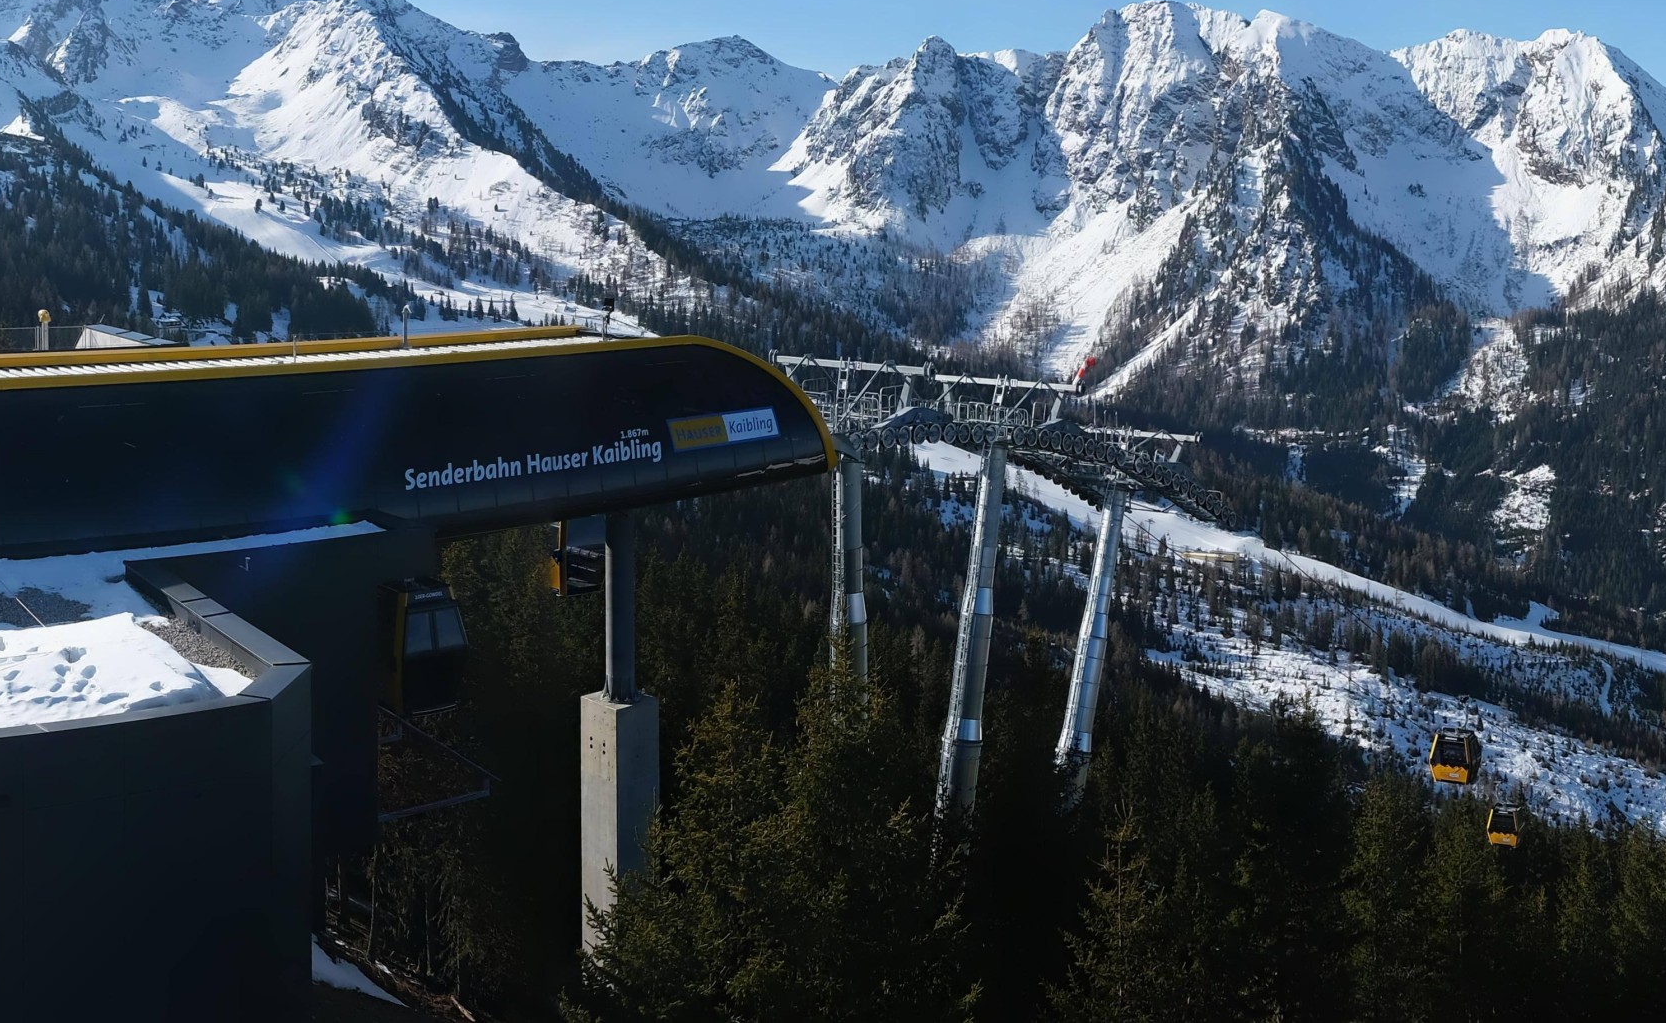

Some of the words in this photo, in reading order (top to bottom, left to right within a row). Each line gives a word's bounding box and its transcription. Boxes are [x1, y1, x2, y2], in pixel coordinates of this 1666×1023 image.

[620, 428, 649, 440] 1.867m
[675, 425, 722, 442] HAUSER
[729, 415, 773, 435] Kaibling
[405, 455, 521, 491] Senderbahn
[527, 451, 589, 475] Hauser
[592, 439, 662, 464] Kaibling
